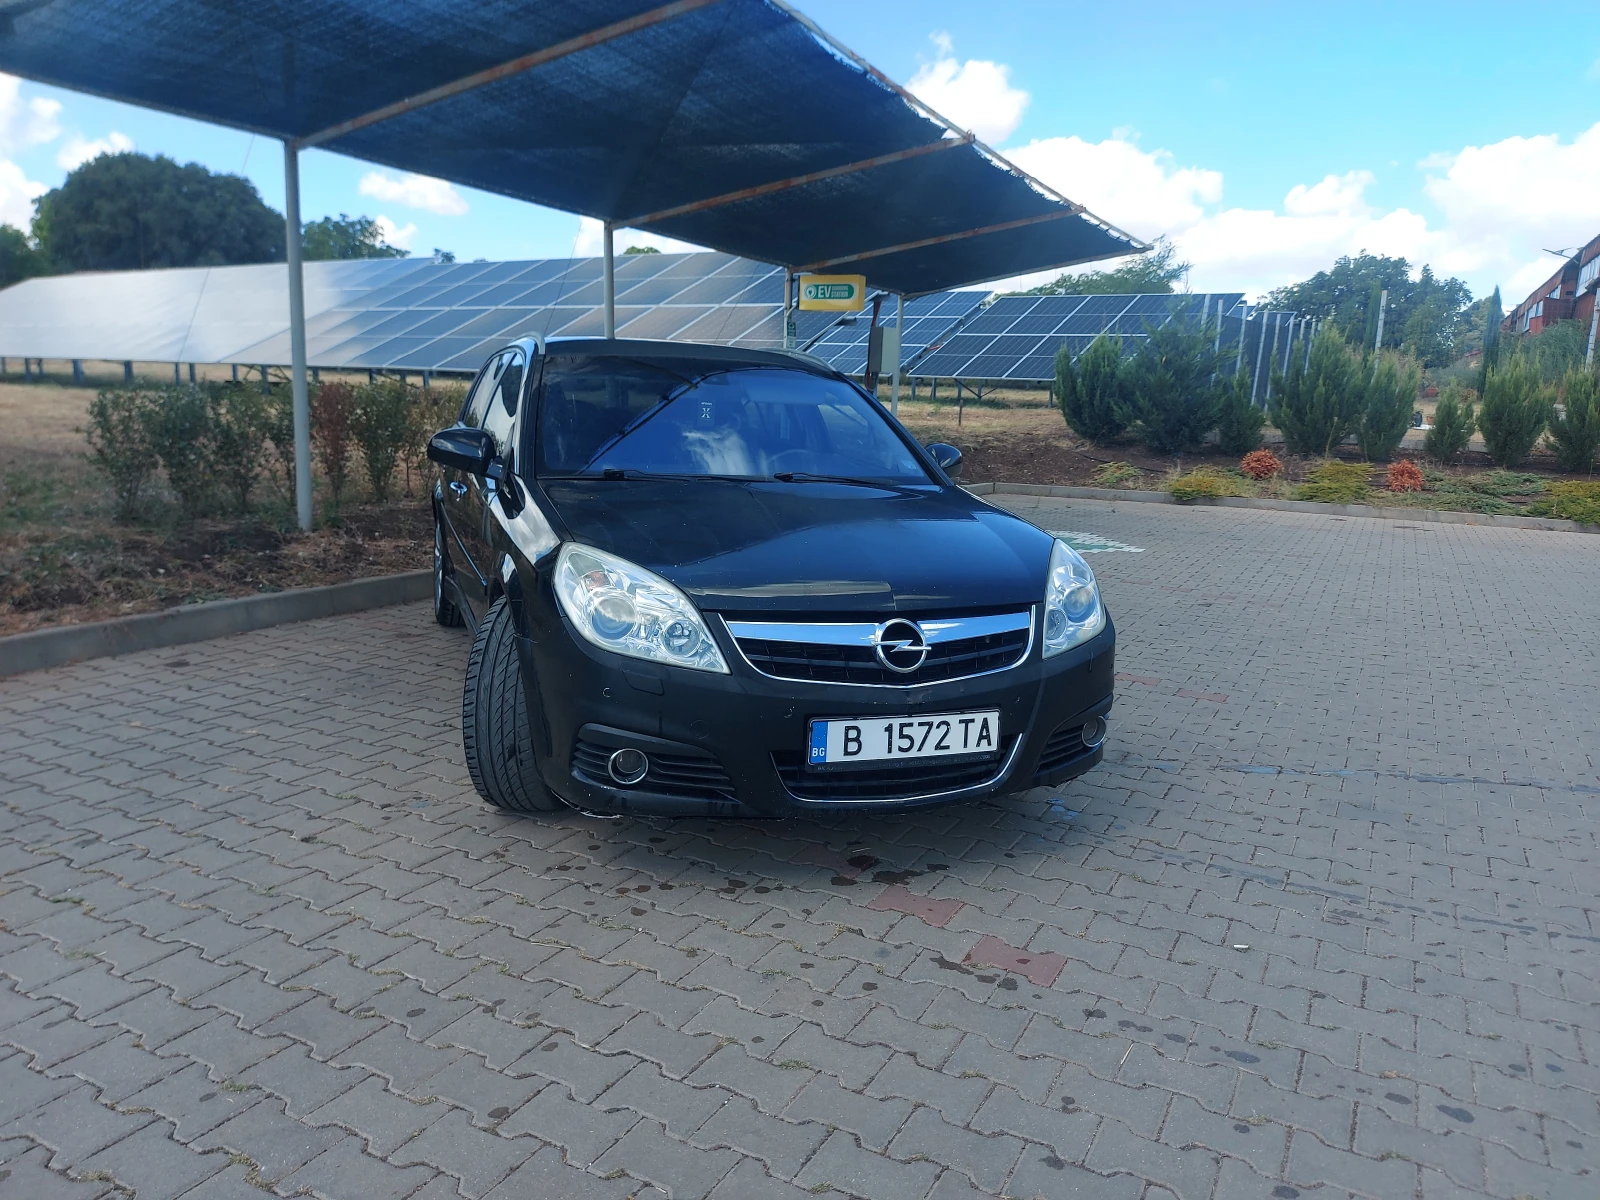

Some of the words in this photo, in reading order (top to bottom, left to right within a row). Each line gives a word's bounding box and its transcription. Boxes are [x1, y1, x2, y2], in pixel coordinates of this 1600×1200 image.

[818, 286, 831, 298] EV
[843, 725, 862, 757] B
[884, 720, 952, 754] 1572
[958, 717, 992, 748] TA
[812, 747, 826, 757] BG
